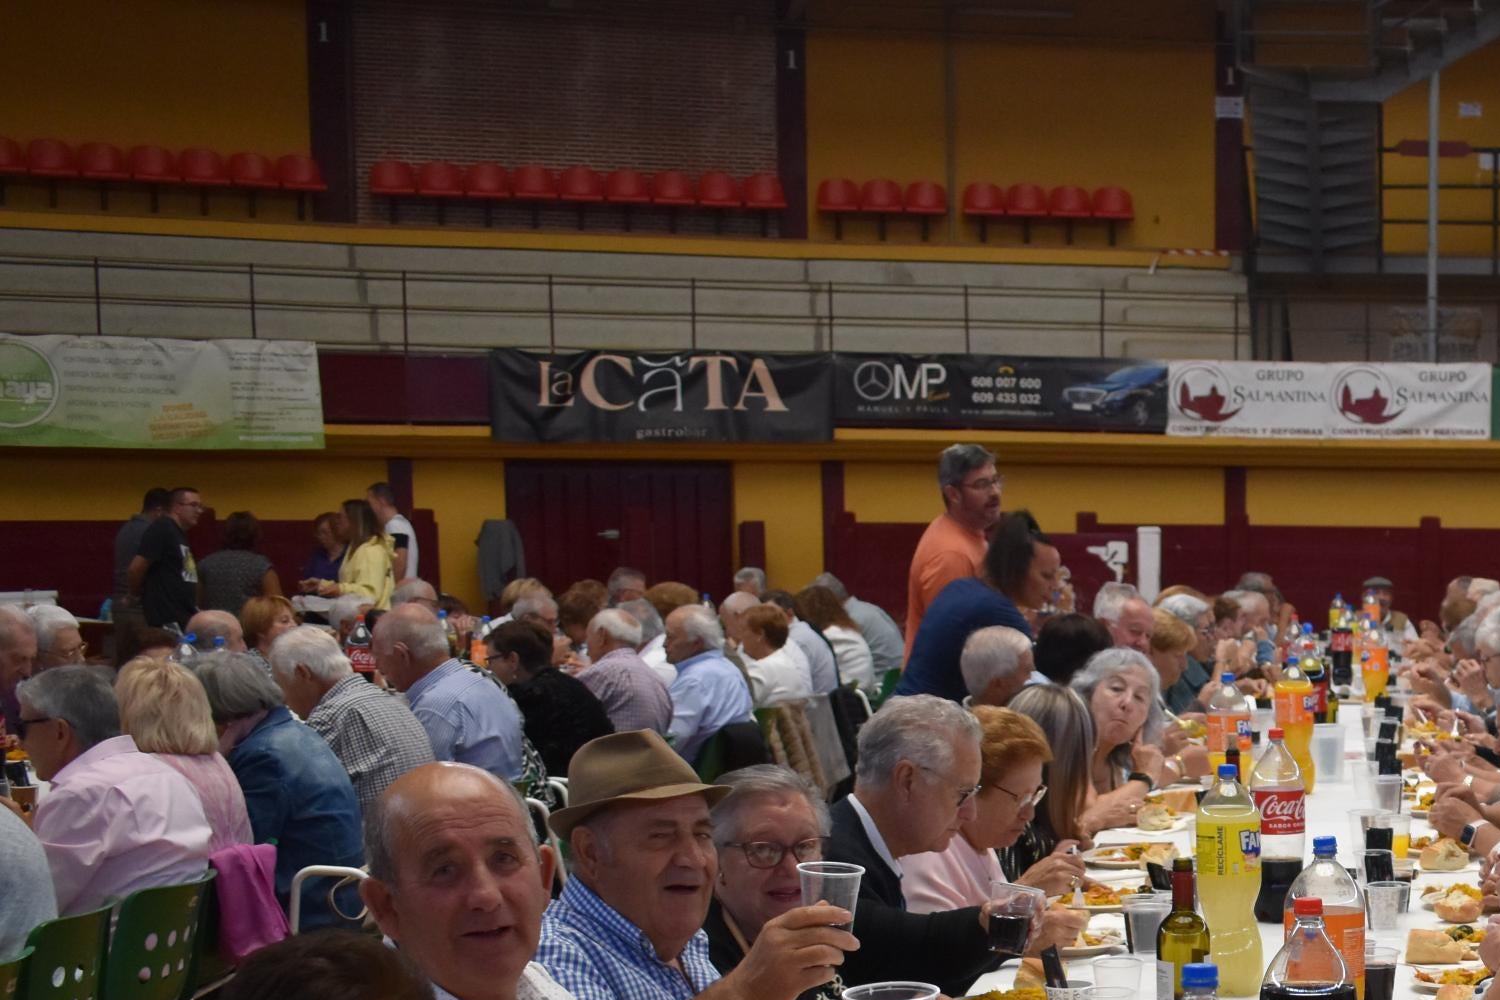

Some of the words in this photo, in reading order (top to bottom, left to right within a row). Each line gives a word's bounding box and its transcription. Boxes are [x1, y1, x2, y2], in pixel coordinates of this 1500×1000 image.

[1255, 369, 1304, 382] GRUPO
[1418, 370, 1468, 383] GRUPO
[0, 381, 53, 405] aya
[1232, 385, 1328, 403] SALMANTINA
[1395, 382, 1488, 404] SALMANTINA
